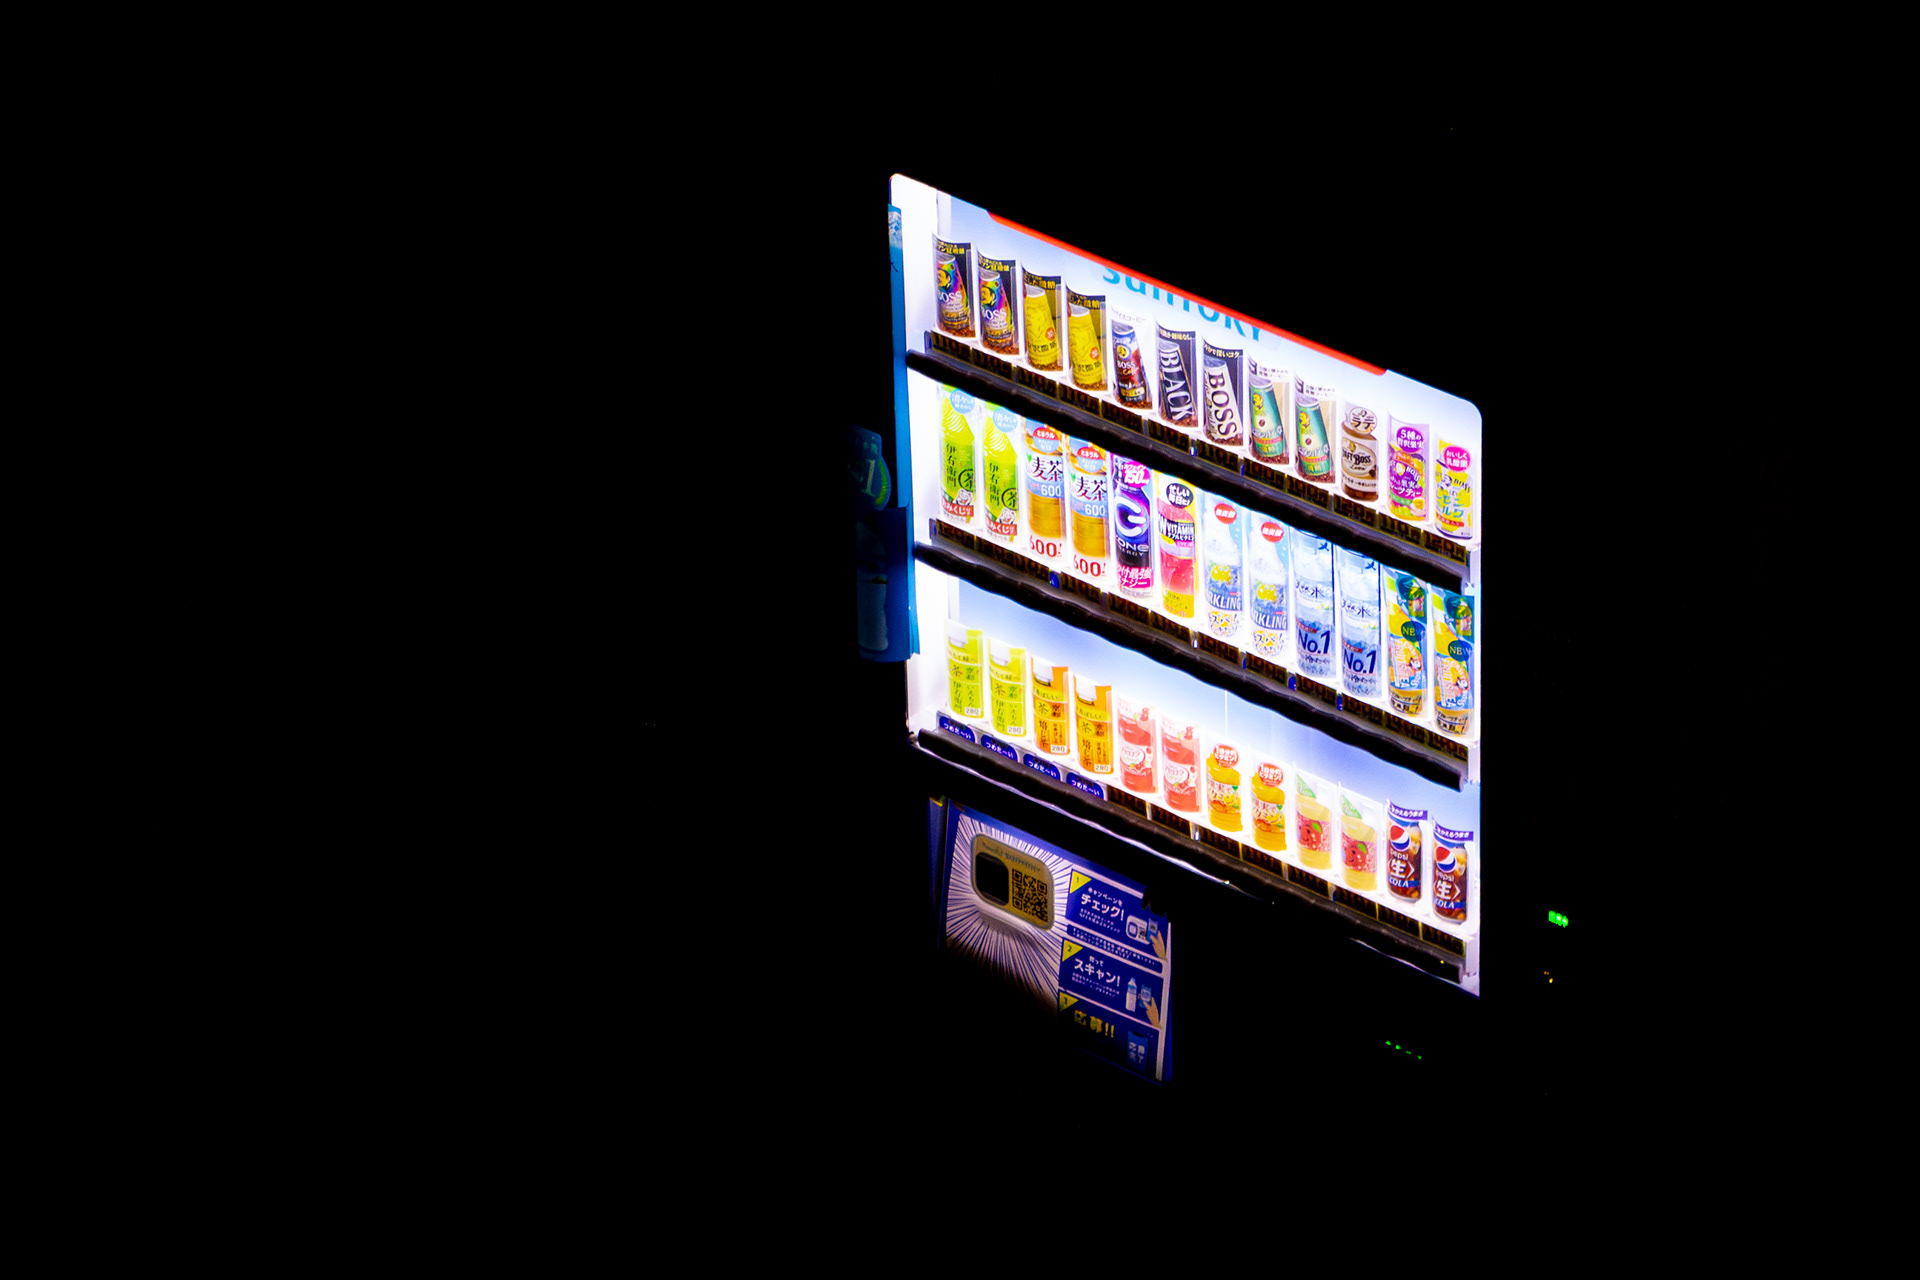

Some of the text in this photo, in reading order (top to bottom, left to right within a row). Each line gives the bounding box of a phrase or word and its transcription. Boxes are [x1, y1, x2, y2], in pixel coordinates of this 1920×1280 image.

[1160, 351, 1195, 420] BLACK
[1208, 371, 1238, 436] BOSS
[946, 442, 957, 487] 伊右衛門
[1033, 456, 1063, 482] 麦茶
[989, 462, 1000, 506] 伊右衛門
[1041, 484, 1062, 497] 600
[1076, 475, 1107, 501] 麦茶
[1085, 503, 1106, 516] 600
[1298, 630, 1331, 655] No.1
[1343, 648, 1377, 674] No.1
[1038, 702, 1049, 714] 茶
[1080, 720, 1092, 733] 茶
[1081, 893, 1124, 921] チェック!
[1074, 958, 1120, 987] スキャン!
